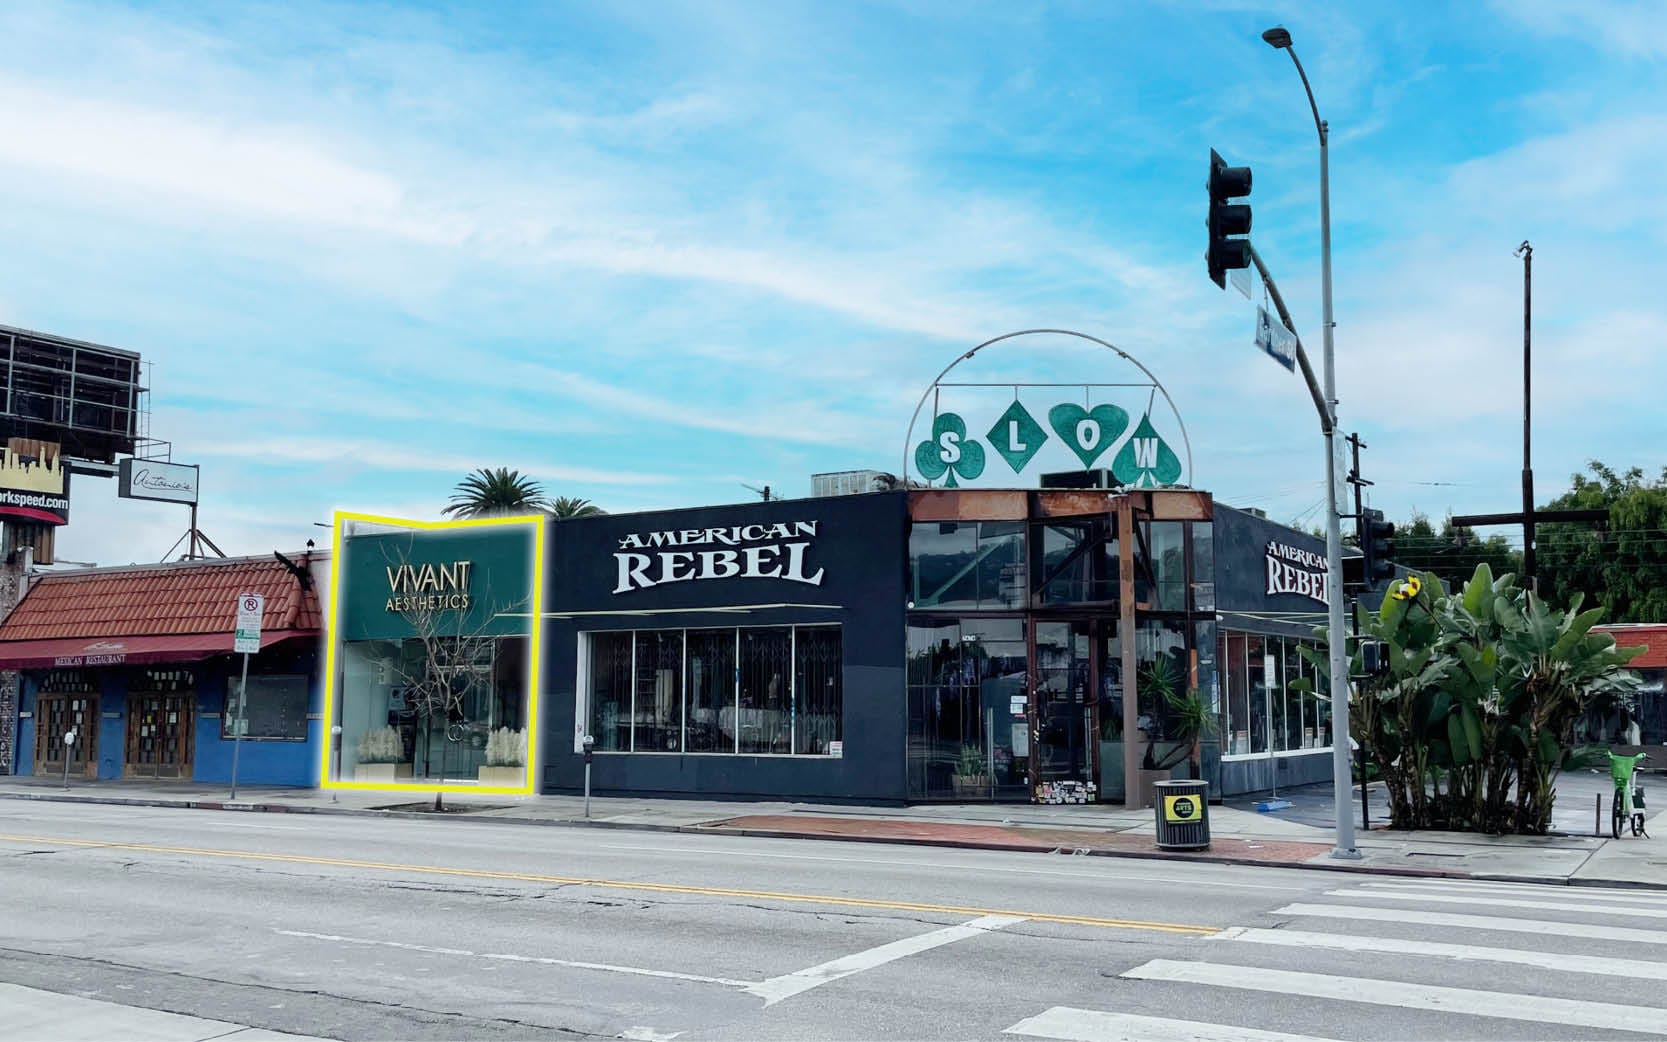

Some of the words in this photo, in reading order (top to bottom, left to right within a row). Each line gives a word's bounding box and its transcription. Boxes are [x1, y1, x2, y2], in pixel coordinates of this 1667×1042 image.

[618, 520, 818, 550] AMERICAN
[386, 561, 471, 593] VIVANT
[611, 542, 825, 594] REBEL
[385, 594, 469, 612] AESTHETICS
[55, 657, 83, 666] MEXICAN
[86, 654, 126, 665] RESTAURANT
